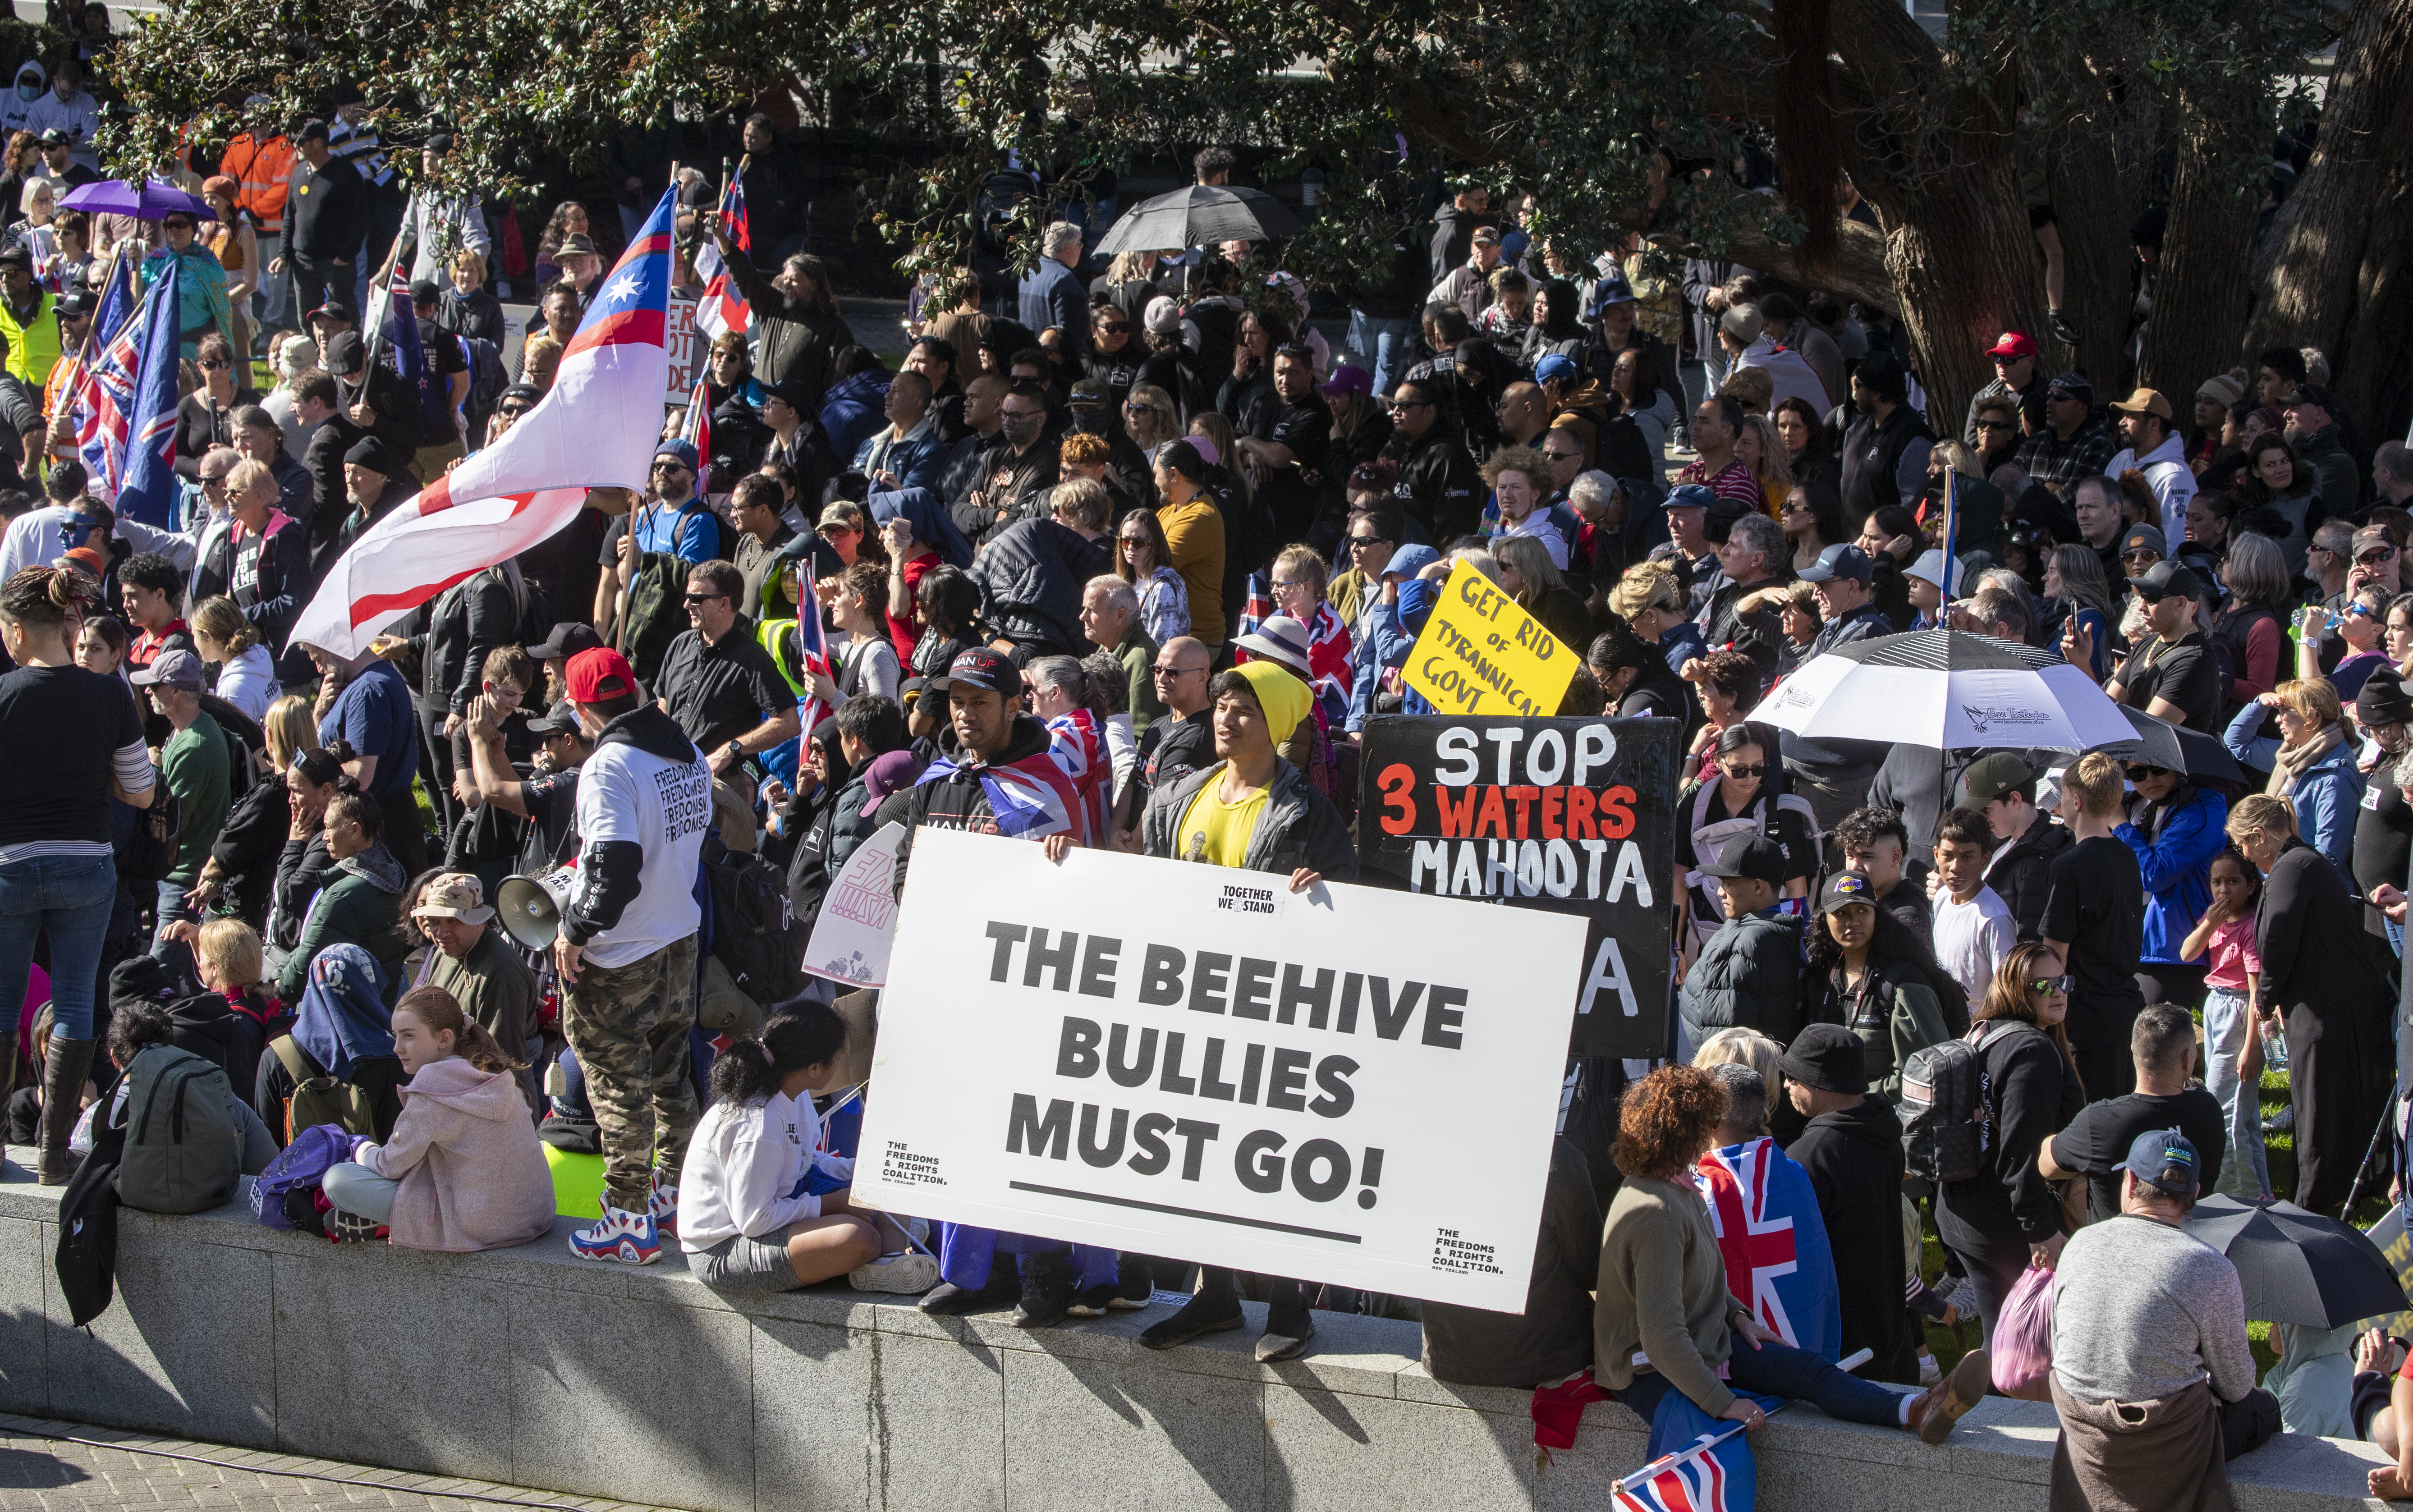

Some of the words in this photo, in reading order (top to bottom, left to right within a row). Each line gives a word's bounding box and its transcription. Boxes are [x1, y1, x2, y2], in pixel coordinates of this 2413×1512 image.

[1461, 576, 1509, 622] GET
[1514, 617, 1554, 661] RID
[1486, 632, 1511, 653] OF
[952, 656, 976, 668] MAN
[977, 657, 997, 667] UP
[971, 670, 995, 678] TANGATA
[1423, 656, 1488, 715] GOVT
[2006, 707, 2050, 722] Tatupu
[1435, 723, 1617, 787] STOP
[1377, 763, 1417, 835] 3
[1436, 785, 1637, 841] WATERS
[1411, 838, 1653, 907] MAHOOTA
[1223, 885, 1273, 902] TOGETHER
[1218, 897, 1233, 910] WE
[1243, 900, 1275, 914] STAND
[985, 920, 1122, 999] THE
[1138, 943, 1469, 1050] BEEHIVE
[1055, 1016, 1361, 1118] BULLIES
[888, 1141, 908, 1151] THE
[1005, 1092, 1220, 1182] MUST
[1234, 1129, 1385, 1210] GO!
[2165, 1147, 2190, 1157] VOICES
[885, 1150, 940, 1165] FREEDOMS
[2165, 1151, 2191, 1162] FREEDOM
[898, 1161, 938, 1174] RIGHTS
[882, 1168, 947, 1186] COALITION.
[252, 1186, 262, 1204] ARE
[1437, 1228, 1460, 1238] THE
[1436, 1237, 1495, 1254] FREEDOMS
[1434, 1247, 1441, 1255] &
[1449, 1249, 1493, 1263] RIGHTS
[1432, 1256, 1504, 1275] COALITION.
